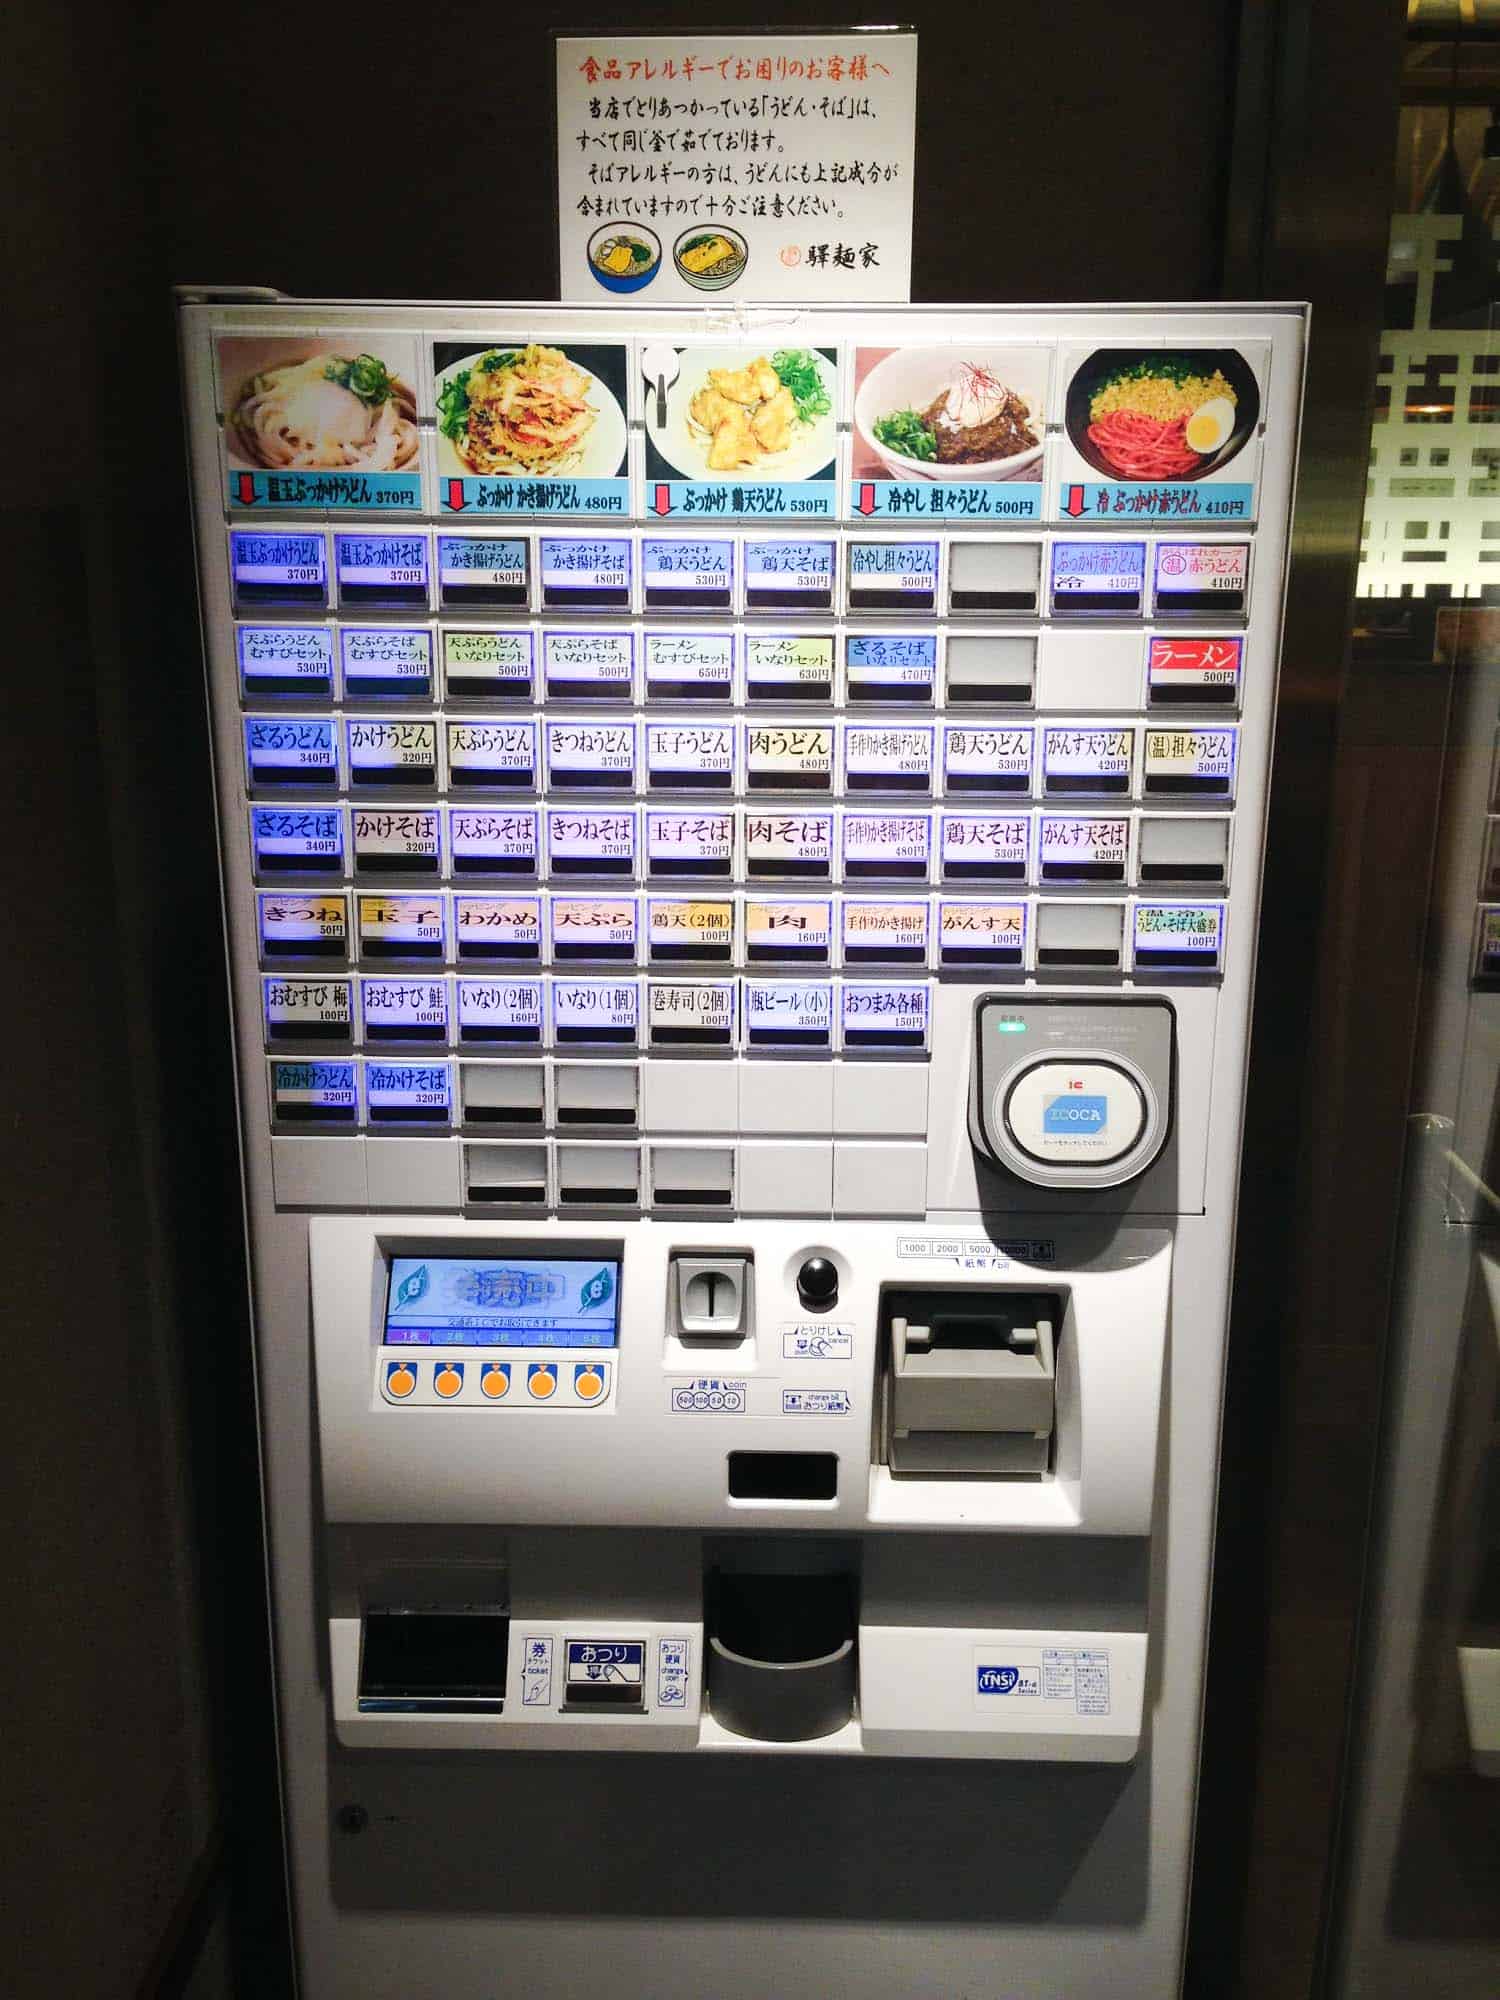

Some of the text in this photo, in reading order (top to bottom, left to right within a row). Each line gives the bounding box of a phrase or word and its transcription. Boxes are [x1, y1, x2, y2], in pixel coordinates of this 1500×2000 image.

[578, 54, 891, 83] 食品アレルギーでお困りのお客様へ
[576, 129, 784, 153] すべて同じ釜で茹でております。
[588, 161, 898, 185] そばアレルギーの方は、うどんにも上記成分が
[576, 193, 848, 219] 含まれていますので十分ご注意ください。
[376, 490, 414, 504] 370円
[477, 483, 622, 510] ぶっかけ かき揚げうどん 480円
[682, 486, 828, 513] ぶっかけ 鶏天うどん 530円
[887, 487, 926, 513] 冷やし
[995, 501, 1034, 515] 500円
[1096, 487, 1110, 514] 冷
[1206, 500, 1244, 515] 410円
[452, 551, 523, 568] かき揚げうどん
[553, 554, 624, 570] かき揚げそば
[658, 556, 725, 571] 鶏天うどん
[762, 556, 828, 572] 鶏天そば
[288, 569, 318, 581] 370円
[390, 570, 421, 582] 370円
[492, 572, 523, 584] 480円
[594, 574, 624, 585] 480円
[696, 574, 726, 586] 530円
[798, 575, 828, 586] 530円
[901, 576, 932, 588] 500円
[1107, 576, 1138, 588] 410円
[1212, 577, 1242, 588] 410円
[246, 634, 320, 645] 天ぷらうどん
[449, 637, 520, 648] 天ぷらうどん
[650, 639, 697, 649] ラーメン
[749, 640, 798, 651] ラーメン
[250, 647, 327, 659] むすびセット
[351, 648, 427, 660] むすびセット
[853, 640, 925, 656] ざるそば
[456, 650, 525, 662] いなりセット
[554, 651, 627, 663] いなりセット
[654, 652, 728, 664] むすびセット
[756, 654, 828, 665] いなりセット
[1153, 644, 1235, 667] ラーメン
[296, 663, 327, 673] 530円
[397, 664, 427, 675] 530円
[498, 665, 528, 676] 500円
[599, 667, 628, 677] 500円
[698, 668, 728, 678] 650円
[799, 668, 829, 680] 630円
[900, 669, 931, 680] 470円
[1203, 672, 1234, 682] 500円
[251, 726, 330, 748] ざるうどん
[352, 726, 432, 748] かけうどん
[452, 730, 529, 752] 天ぷらうどん
[551, 730, 631, 753] きつねうどん
[653, 731, 728, 754] 玉子うどん
[750, 733, 828, 754] 肉うどん
[949, 732, 1027, 755] 鶏天うどん
[1048, 733, 1128, 756] がんす天うどん
[300, 752, 330, 764] 340円
[402, 753, 432, 764] 320円
[502, 755, 531, 766] 370円
[602, 756, 630, 768] 370円
[700, 758, 730, 769] 370円
[799, 758, 828, 770] 480円
[898, 759, 928, 770] 480円
[999, 760, 1027, 770] 530円
[1098, 759, 1128, 770] 420円
[1198, 762, 1228, 773] 500円
[257, 814, 336, 837] ざるそば
[356, 816, 434, 840] かけそば
[456, 818, 533, 840] 天ぷらそば
[552, 818, 630, 840] きつねそば
[652, 819, 729, 842] 玉子そば
[748, 820, 827, 843] 肉そば
[946, 822, 1025, 845] 鶏天そば
[1044, 823, 1124, 846] がんす天そば
[306, 840, 335, 852] 340円
[406, 842, 435, 853] 320円
[504, 843, 533, 854] 370円
[602, 844, 630, 855] 370円
[700, 845, 728, 856] 370円
[798, 846, 827, 857] 480円
[896, 846, 924, 857] 480円
[994, 848, 1024, 859] 530円
[1094, 849, 1123, 860] 420円
[265, 906, 342, 922] きつね
[363, 909, 438, 924] 玉子
[460, 912, 537, 926] わかめ
[556, 913, 632, 927] 天ぷら
[652, 914, 729, 928] 鶏天(2個)
[768, 914, 806, 930] 肉
[847, 916, 924, 930] 手作りかき揚げ
[943, 917, 1020, 931] がんす天
[320, 924, 343, 935] 50円
[417, 927, 440, 938] 50円
[514, 928, 536, 940] 50円
[609, 929, 632, 940] 50円
[700, 930, 728, 941] 100円
[798, 932, 826, 943] 160円
[895, 934, 924, 944] 160円
[991, 934, 1020, 944] 100円
[1187, 937, 1216, 947] 100円
[270, 986, 347, 1007] おむすび 梅
[366, 987, 444, 1009] おむすび 鮭
[461, 988, 538, 1010] いなり(2個)
[557, 989, 634, 1011] いなり(1個)
[654, 990, 729, 1011] 巻寿司(2個)
[752, 990, 829, 1011] 瓶ビール(小)
[847, 992, 923, 1013] おつまみ各種
[320, 1010, 347, 1022] 100円
[415, 1012, 443, 1022] 100円
[510, 1012, 538, 1023] 160円
[612, 1014, 634, 1024] 80円
[700, 1015, 728, 1026] 100円
[798, 1016, 827, 1026] 350円
[896, 1017, 923, 1027] 150円
[278, 1067, 352, 1088] 冷かけうどん
[370, 1070, 444, 1090] 冷かけそば
[323, 1092, 352, 1102] 320円
[416, 1093, 444, 1104] 320円
[904, 1243, 926, 1252] 1000
[936, 1244, 959, 1253] 2000
[968, 1244, 991, 1254] 5000
[800, 1327, 835, 1336] とりけし
[679, 1396, 708, 1404] 500 100
[532, 1641, 546, 1658] 券
[581, 1646, 628, 1663] おつり
